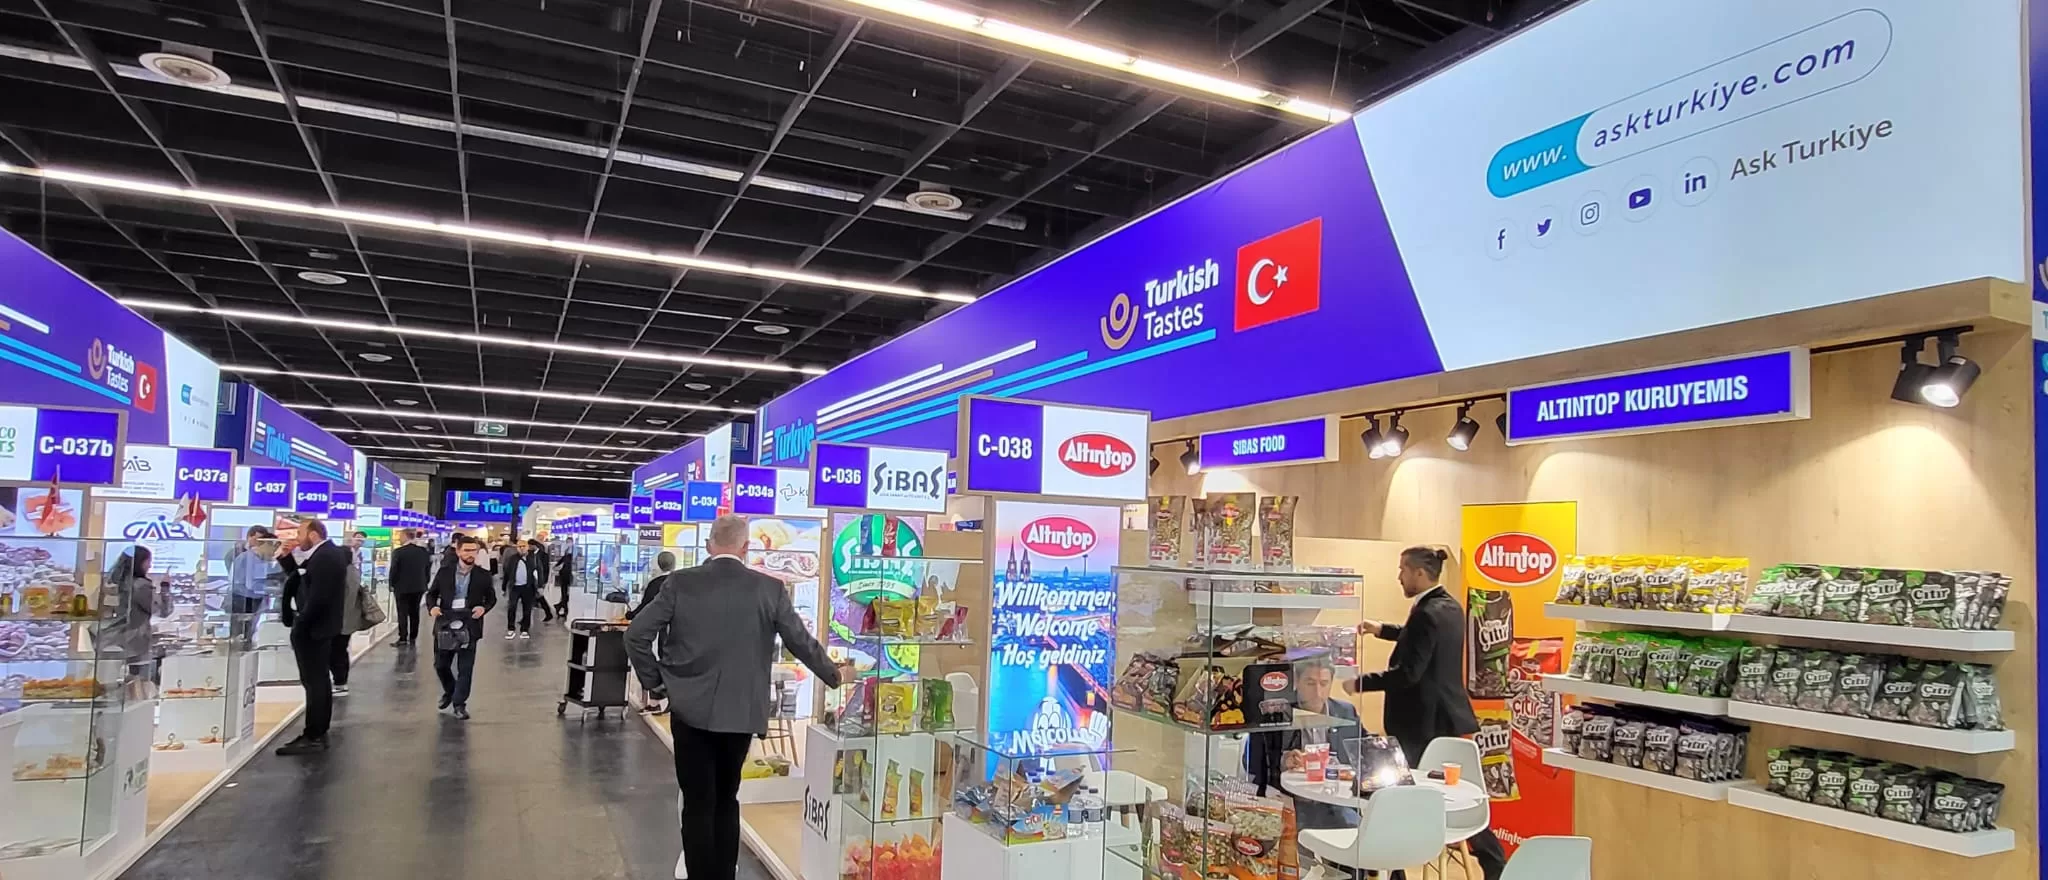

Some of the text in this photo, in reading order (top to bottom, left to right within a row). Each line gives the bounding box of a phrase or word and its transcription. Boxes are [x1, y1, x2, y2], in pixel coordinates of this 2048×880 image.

[1503, 39, 1855, 181] www. askturkiye.com
[1730, 150, 1777, 180] Ask
[1782, 119, 1893, 165] Turkiye
[1145, 258, 1219, 308] Turkish
[1144, 302, 1203, 341] Tastes
[107, 344, 134, 374] Turkish
[106, 366, 129, 393] Tastes
[1537, 375, 1748, 422] ALTINTOP KURUYEMIS
[40, 436, 114, 457] C-037b
[978, 434, 1032, 460] C-038
[1233, 434, 1285, 456] SIBAS FOOD
[179, 468, 228, 483] C-037a
[254, 482, 286, 493] C-037
[822, 467, 861, 485] C-036
[691, 496, 717, 506] C-034
[737, 483, 774, 498] C-034a
[996, 581, 1117, 612] Willkommen
[1013, 613, 1098, 641] Welcome
[1002, 643, 1106, 670] Hoş geldiniz
